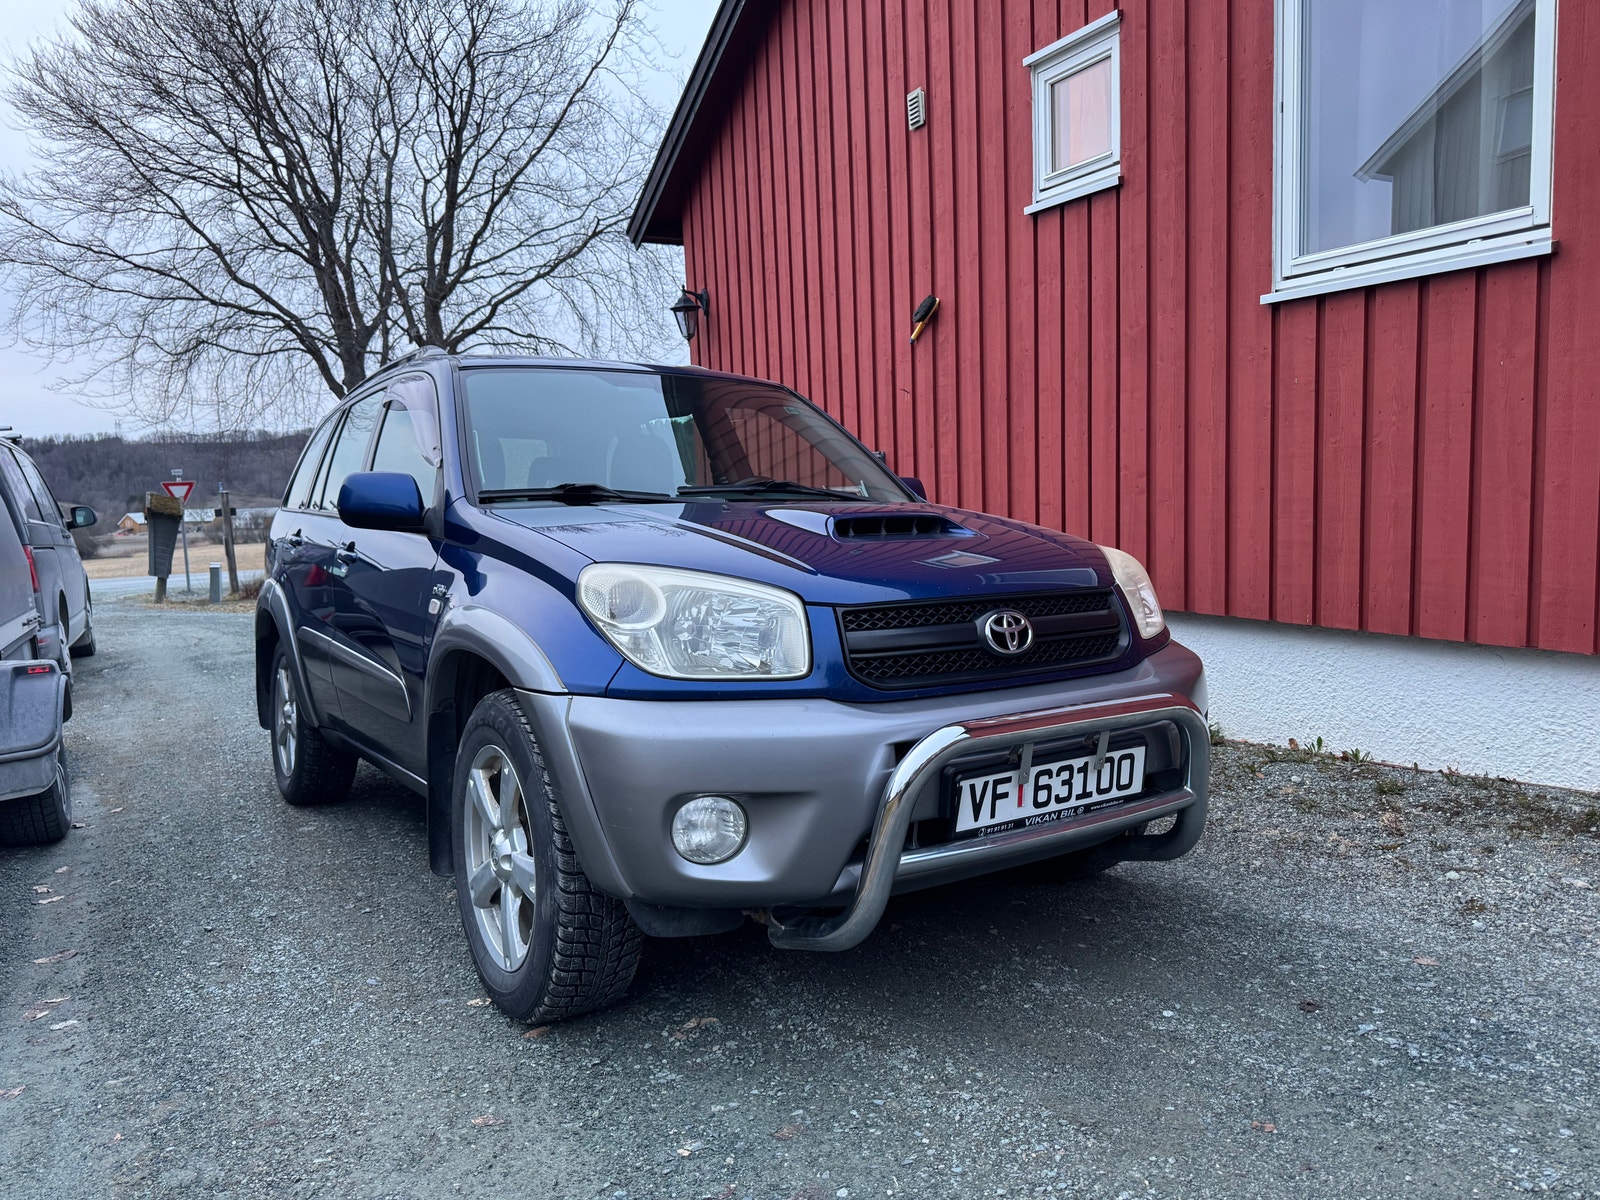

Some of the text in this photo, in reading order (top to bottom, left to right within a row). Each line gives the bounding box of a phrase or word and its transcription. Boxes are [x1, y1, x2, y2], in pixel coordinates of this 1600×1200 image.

[969, 752, 1136, 823] VF 63100
[1025, 808, 1077, 826] VIKAN BIL
